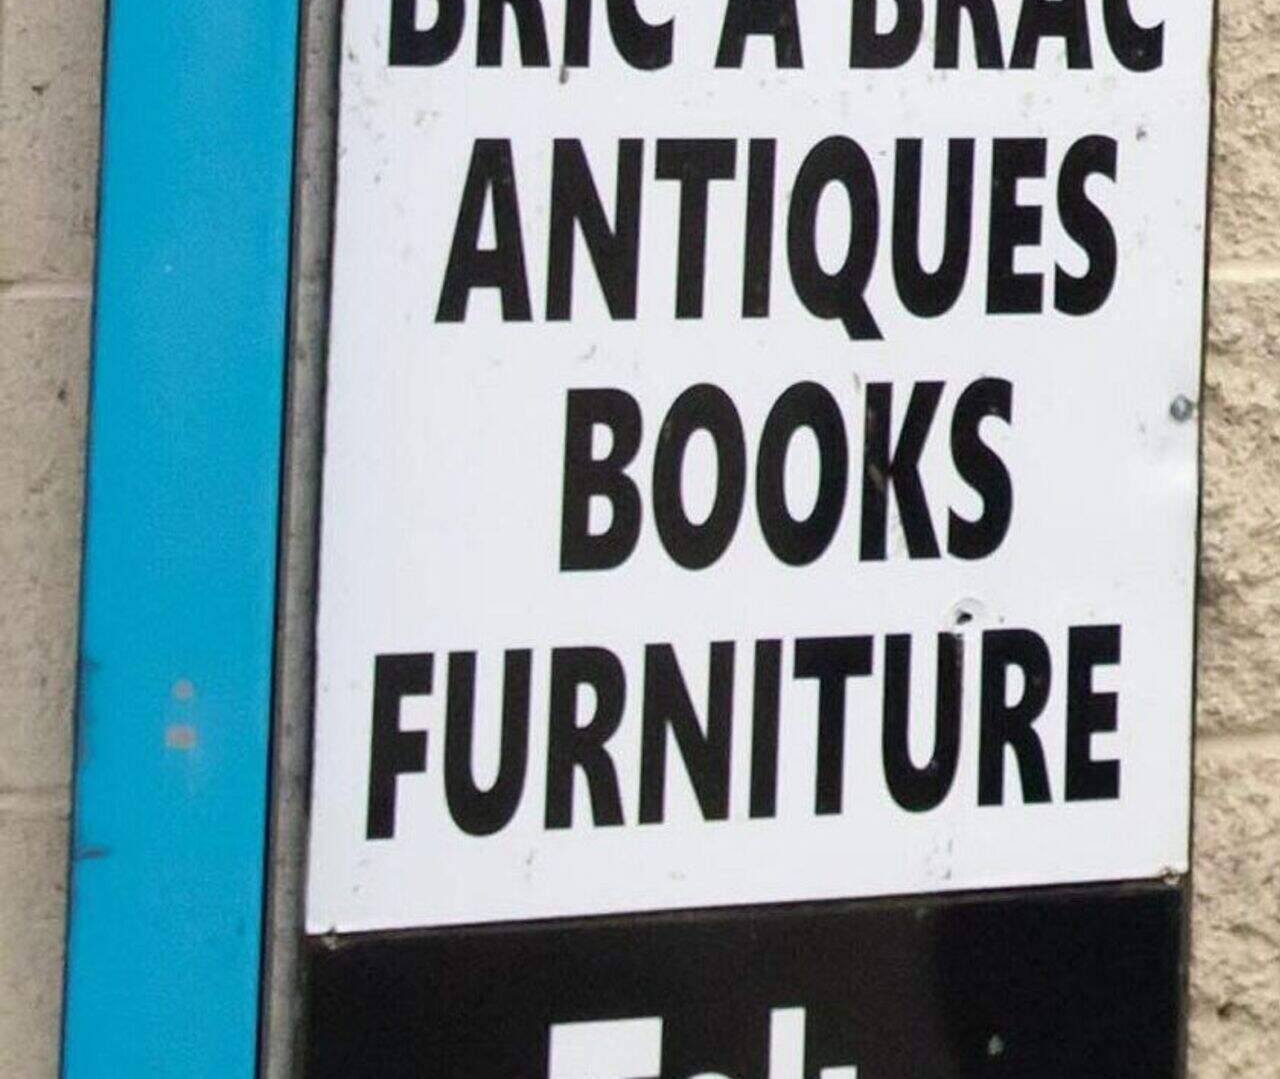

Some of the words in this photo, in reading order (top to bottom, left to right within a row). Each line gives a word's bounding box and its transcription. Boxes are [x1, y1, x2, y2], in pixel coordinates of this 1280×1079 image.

[433, 133, 1119, 342] ANTIQUES
[558, 376, 1014, 573] BOOKS
[365, 623, 1122, 841] FURNITURE
